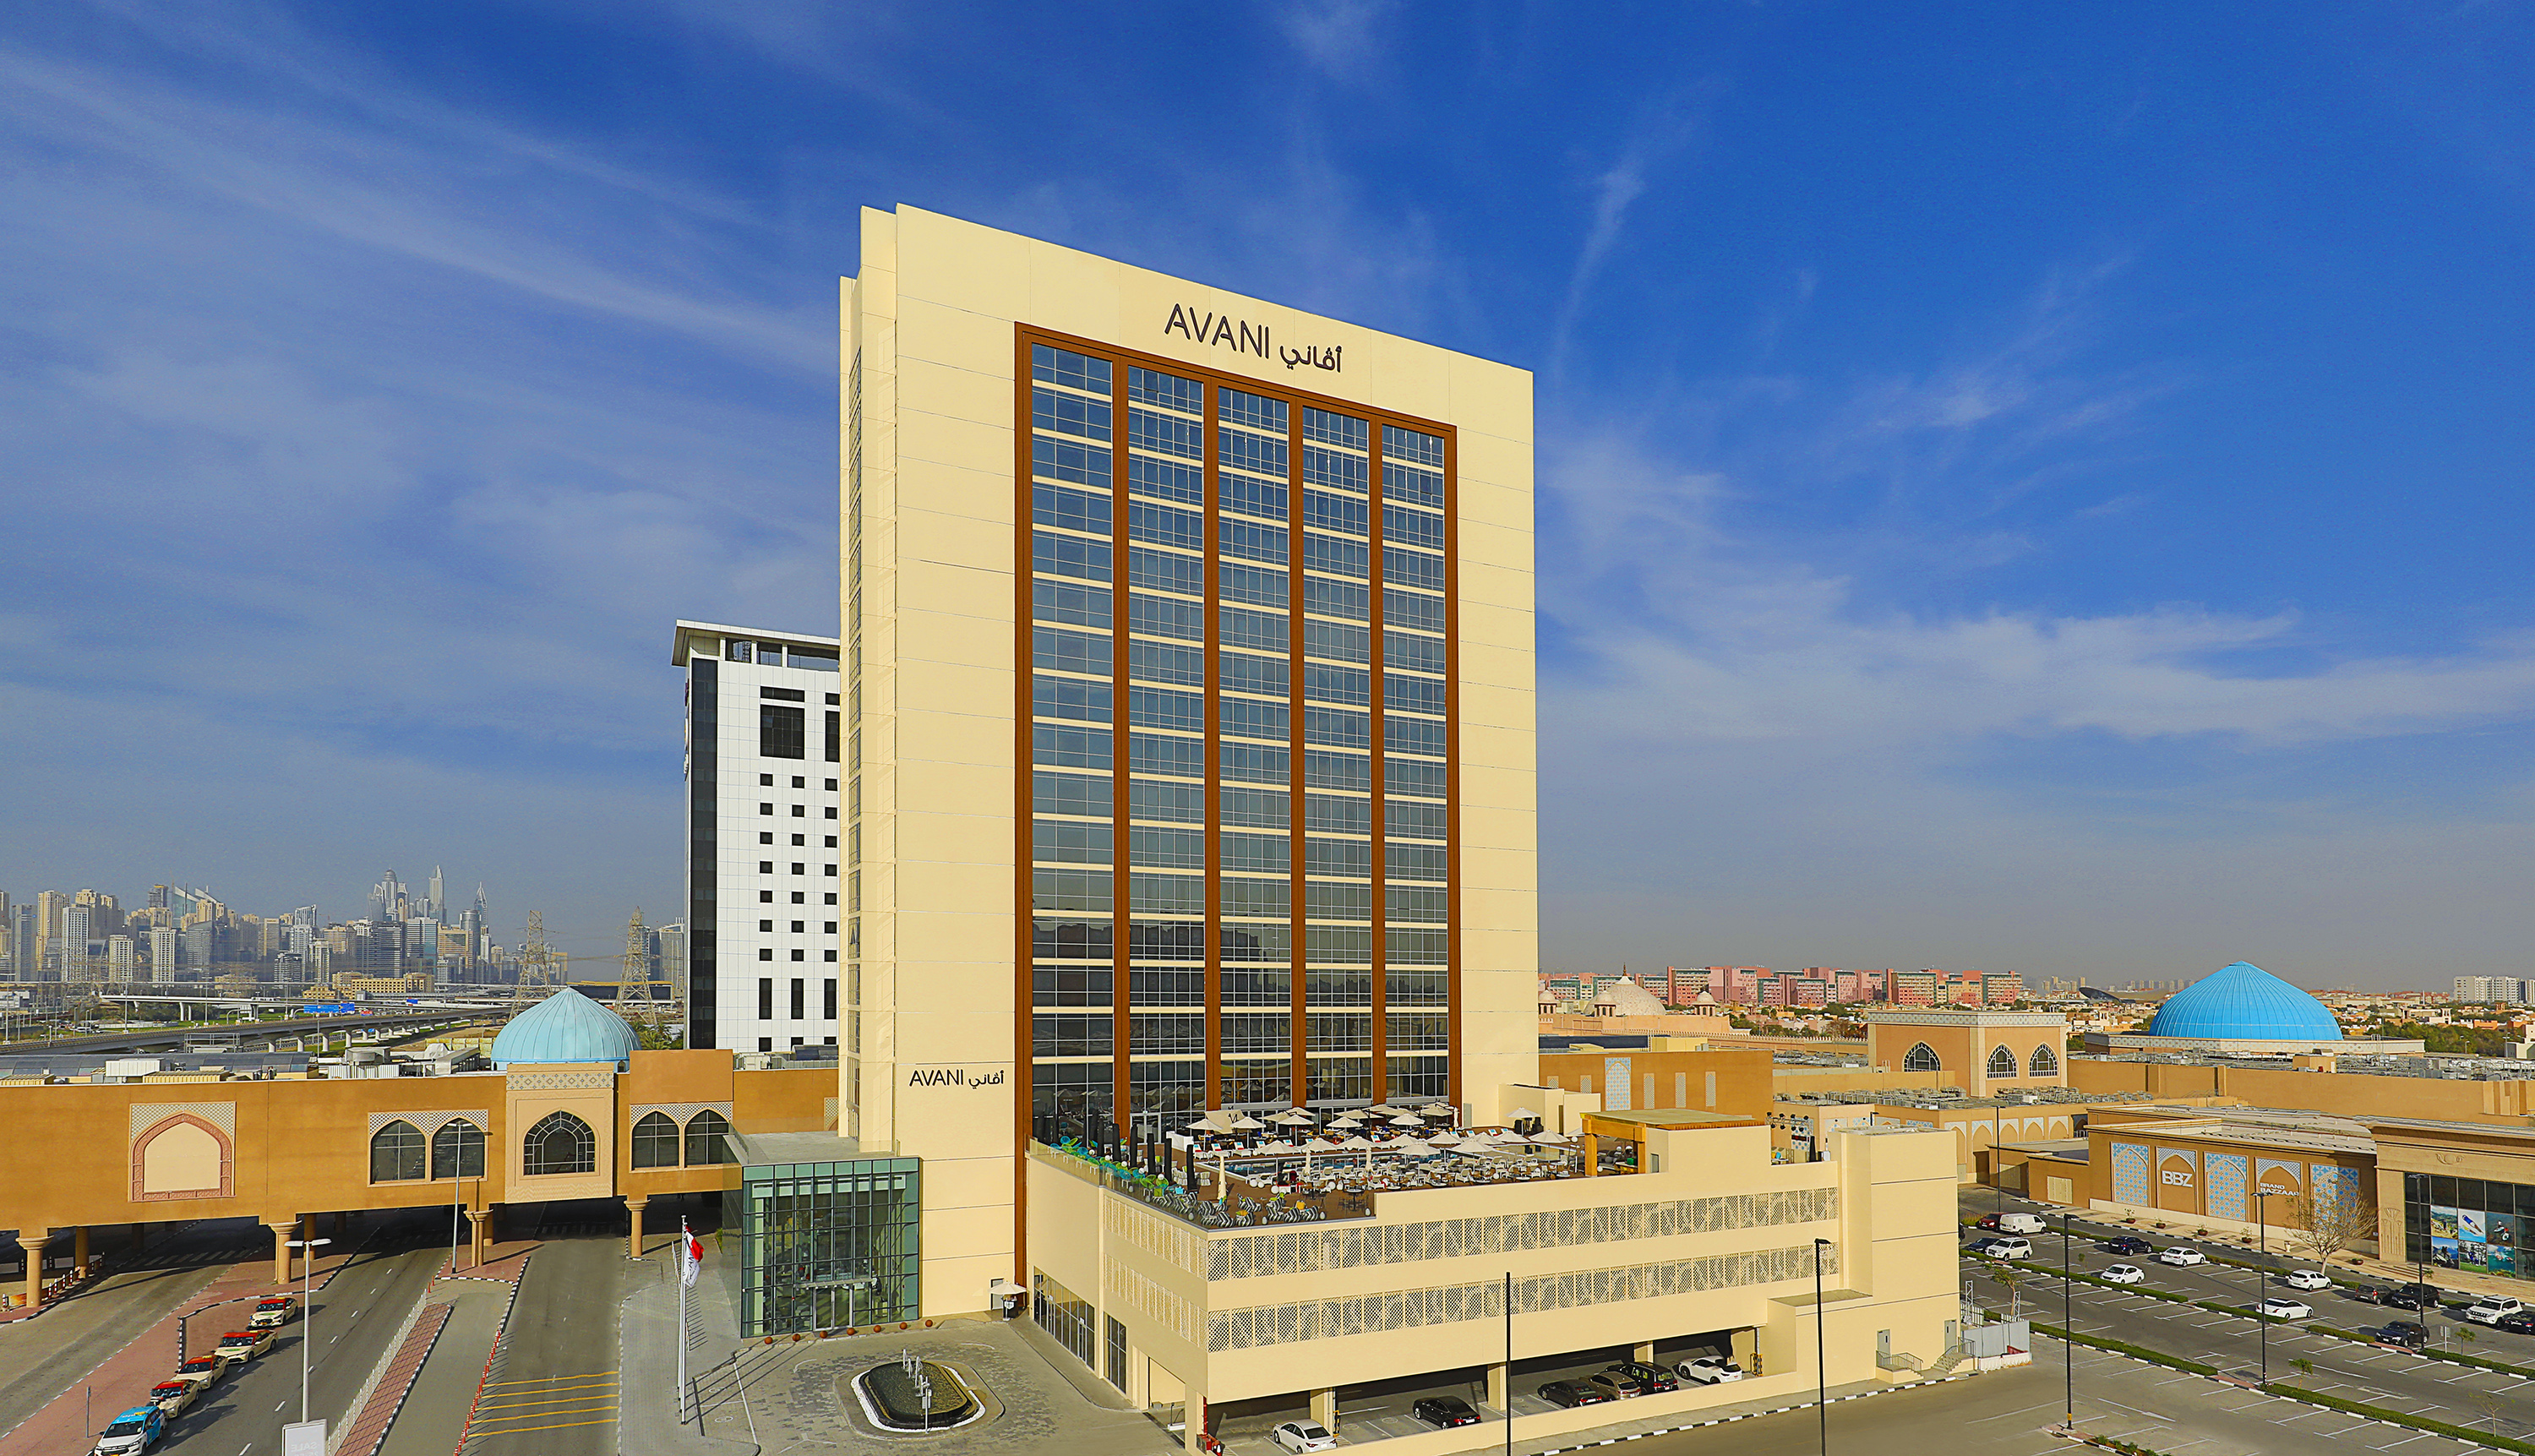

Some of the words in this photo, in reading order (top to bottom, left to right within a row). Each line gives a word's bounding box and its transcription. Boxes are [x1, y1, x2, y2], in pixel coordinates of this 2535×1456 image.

[1164, 303, 1270, 360] AVANI
[908, 1068, 964, 1087] AVANI
[2162, 1170, 2194, 1188] BBZ
